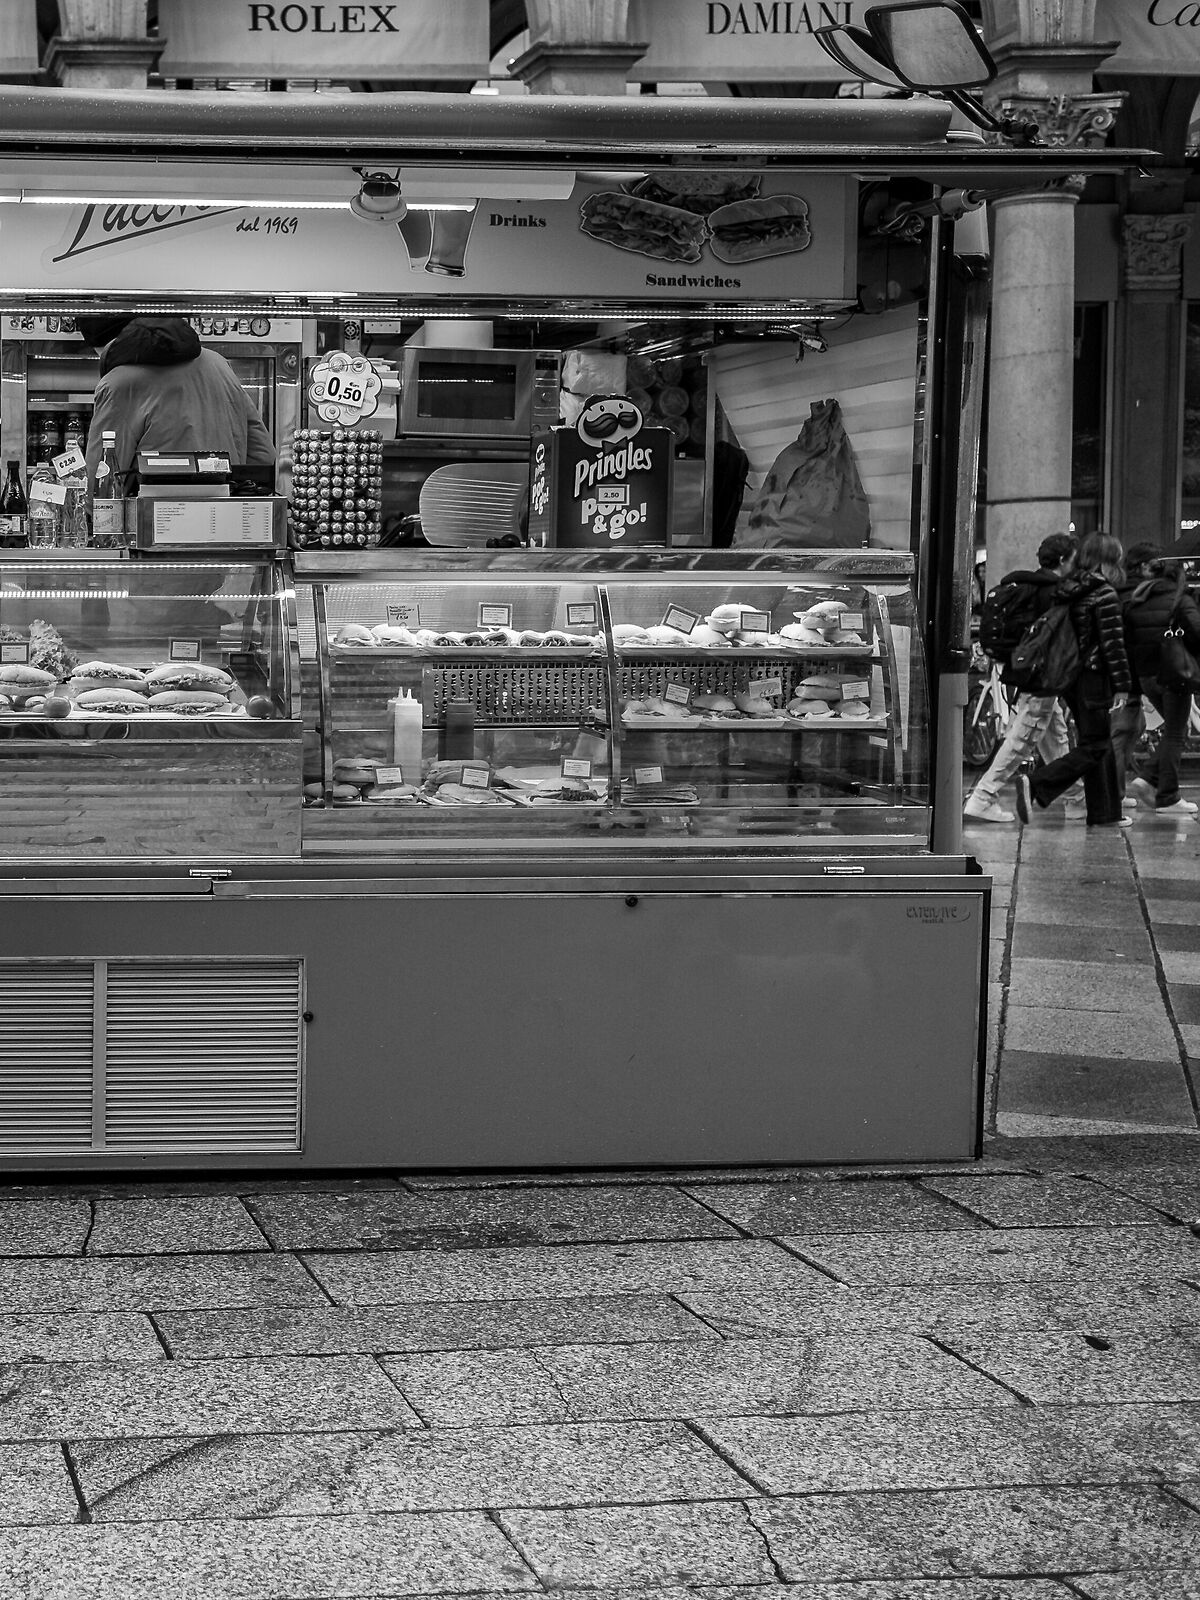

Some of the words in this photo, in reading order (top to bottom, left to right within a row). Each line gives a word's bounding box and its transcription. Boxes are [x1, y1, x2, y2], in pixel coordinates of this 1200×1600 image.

[248, 4, 400, 33] ROLEX
[705, 2, 855, 34] DAMIANI
[236, 216, 260, 232] dal
[264, 216, 299, 234] 1969
[490, 214, 547, 228] Drinks
[646, 273, 742, 289] Sandwiches
[327, 376, 362, 402] 0,50
[574, 441, 653, 498] Pringles
[581, 498, 623, 524] po
[593, 514, 608, 534] &
[609, 502, 647, 540] go!
